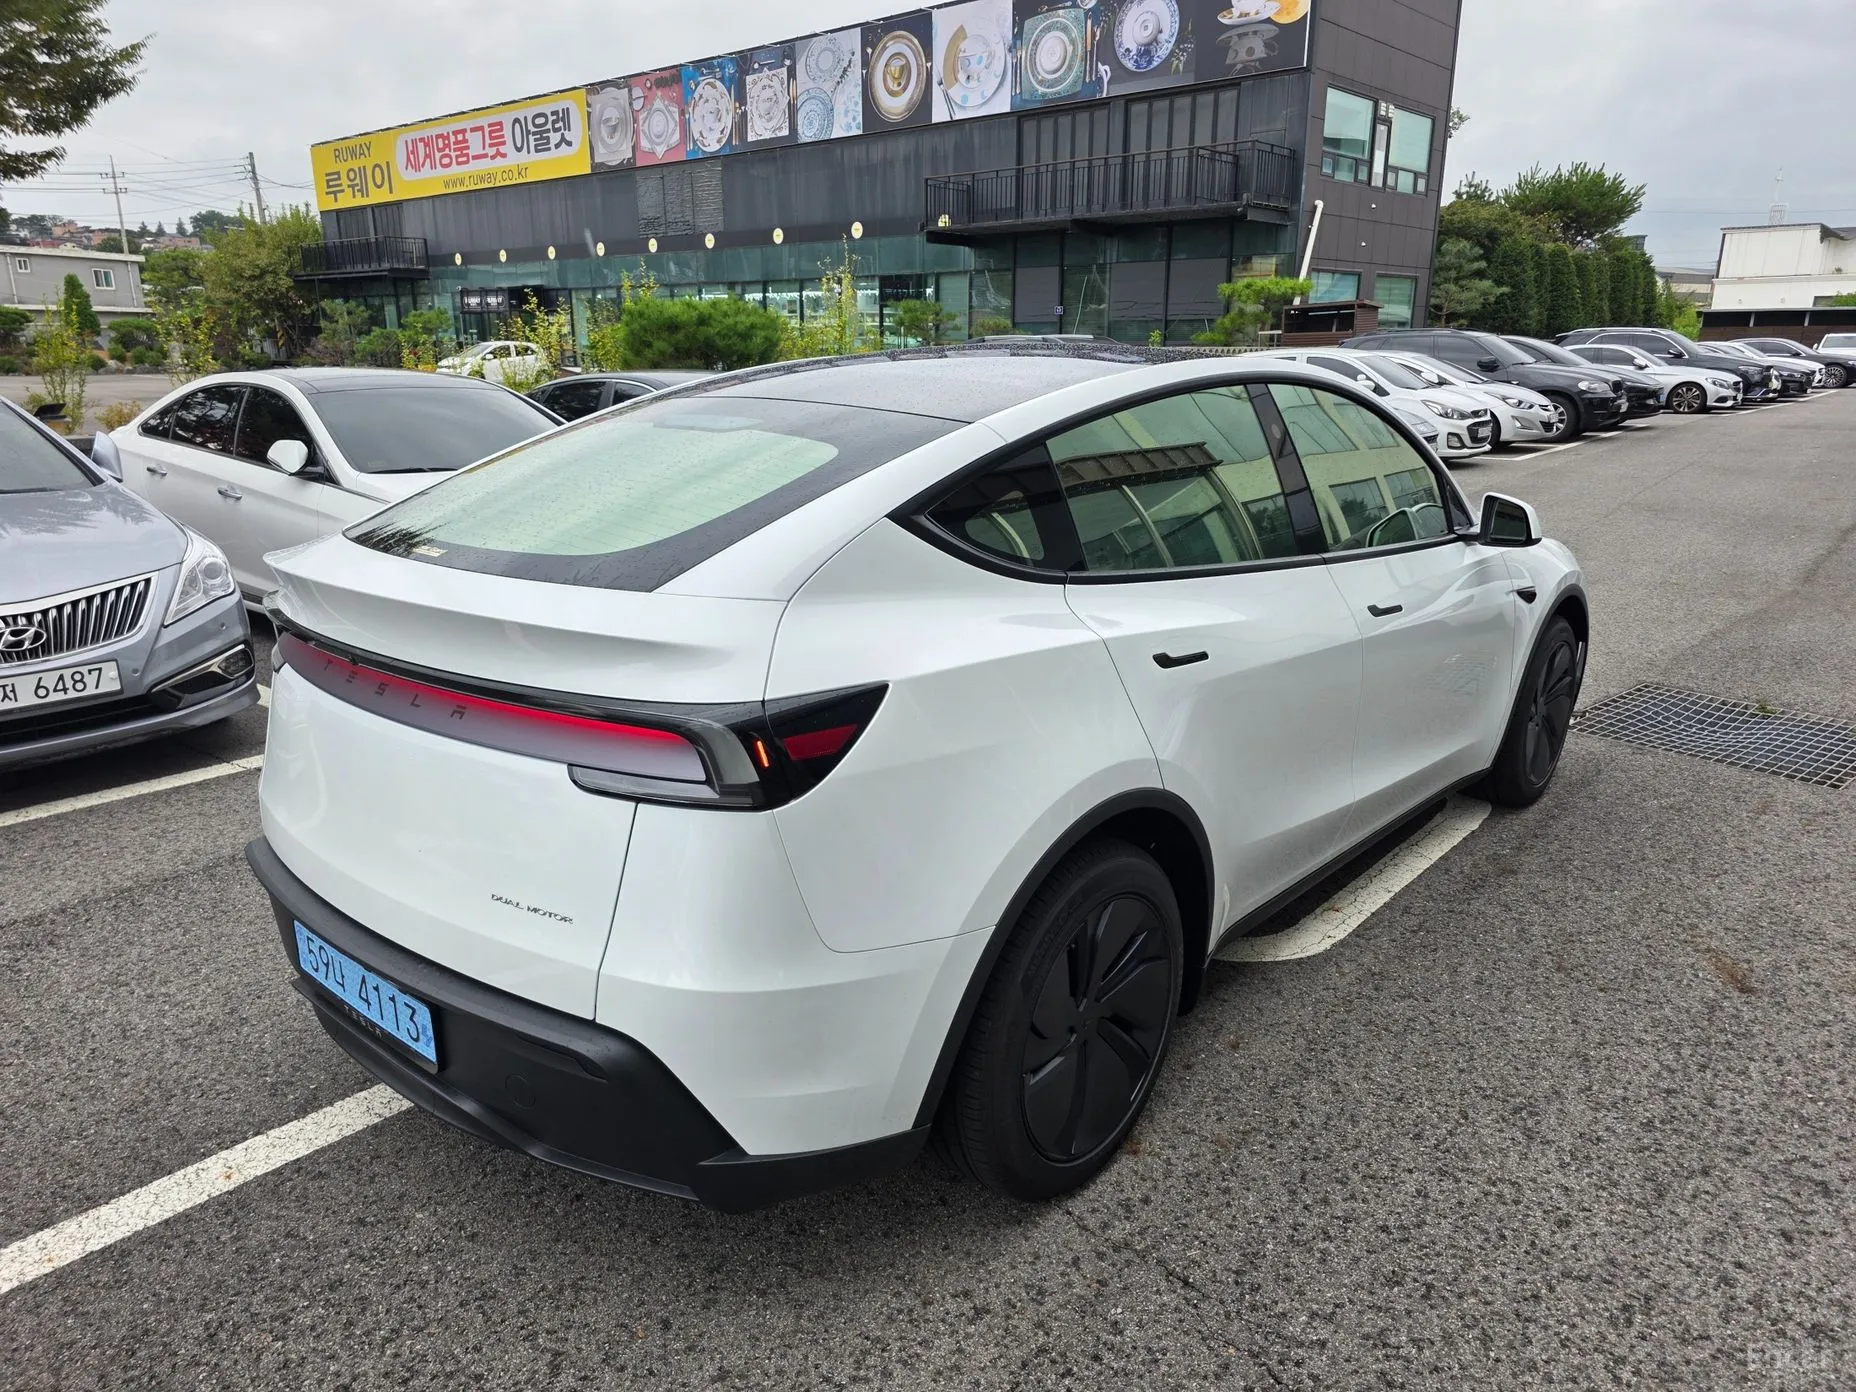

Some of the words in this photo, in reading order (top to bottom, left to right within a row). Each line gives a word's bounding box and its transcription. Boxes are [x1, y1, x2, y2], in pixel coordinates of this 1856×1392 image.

[334, 142, 372, 164] RUWAY
[404, 120, 508, 174] 세계명품그릇
[511, 107, 573, 155] 아울렛
[324, 161, 394, 203] 루웨이
[442, 165, 529, 190] www.ruway.co.kr
[33, 666, 103, 700] 6487
[323, 658, 467, 720] TESLA
[491, 893, 524, 910] DUAL
[527, 904, 573, 925] MOTOR
[358, 974, 420, 1043] 4113
